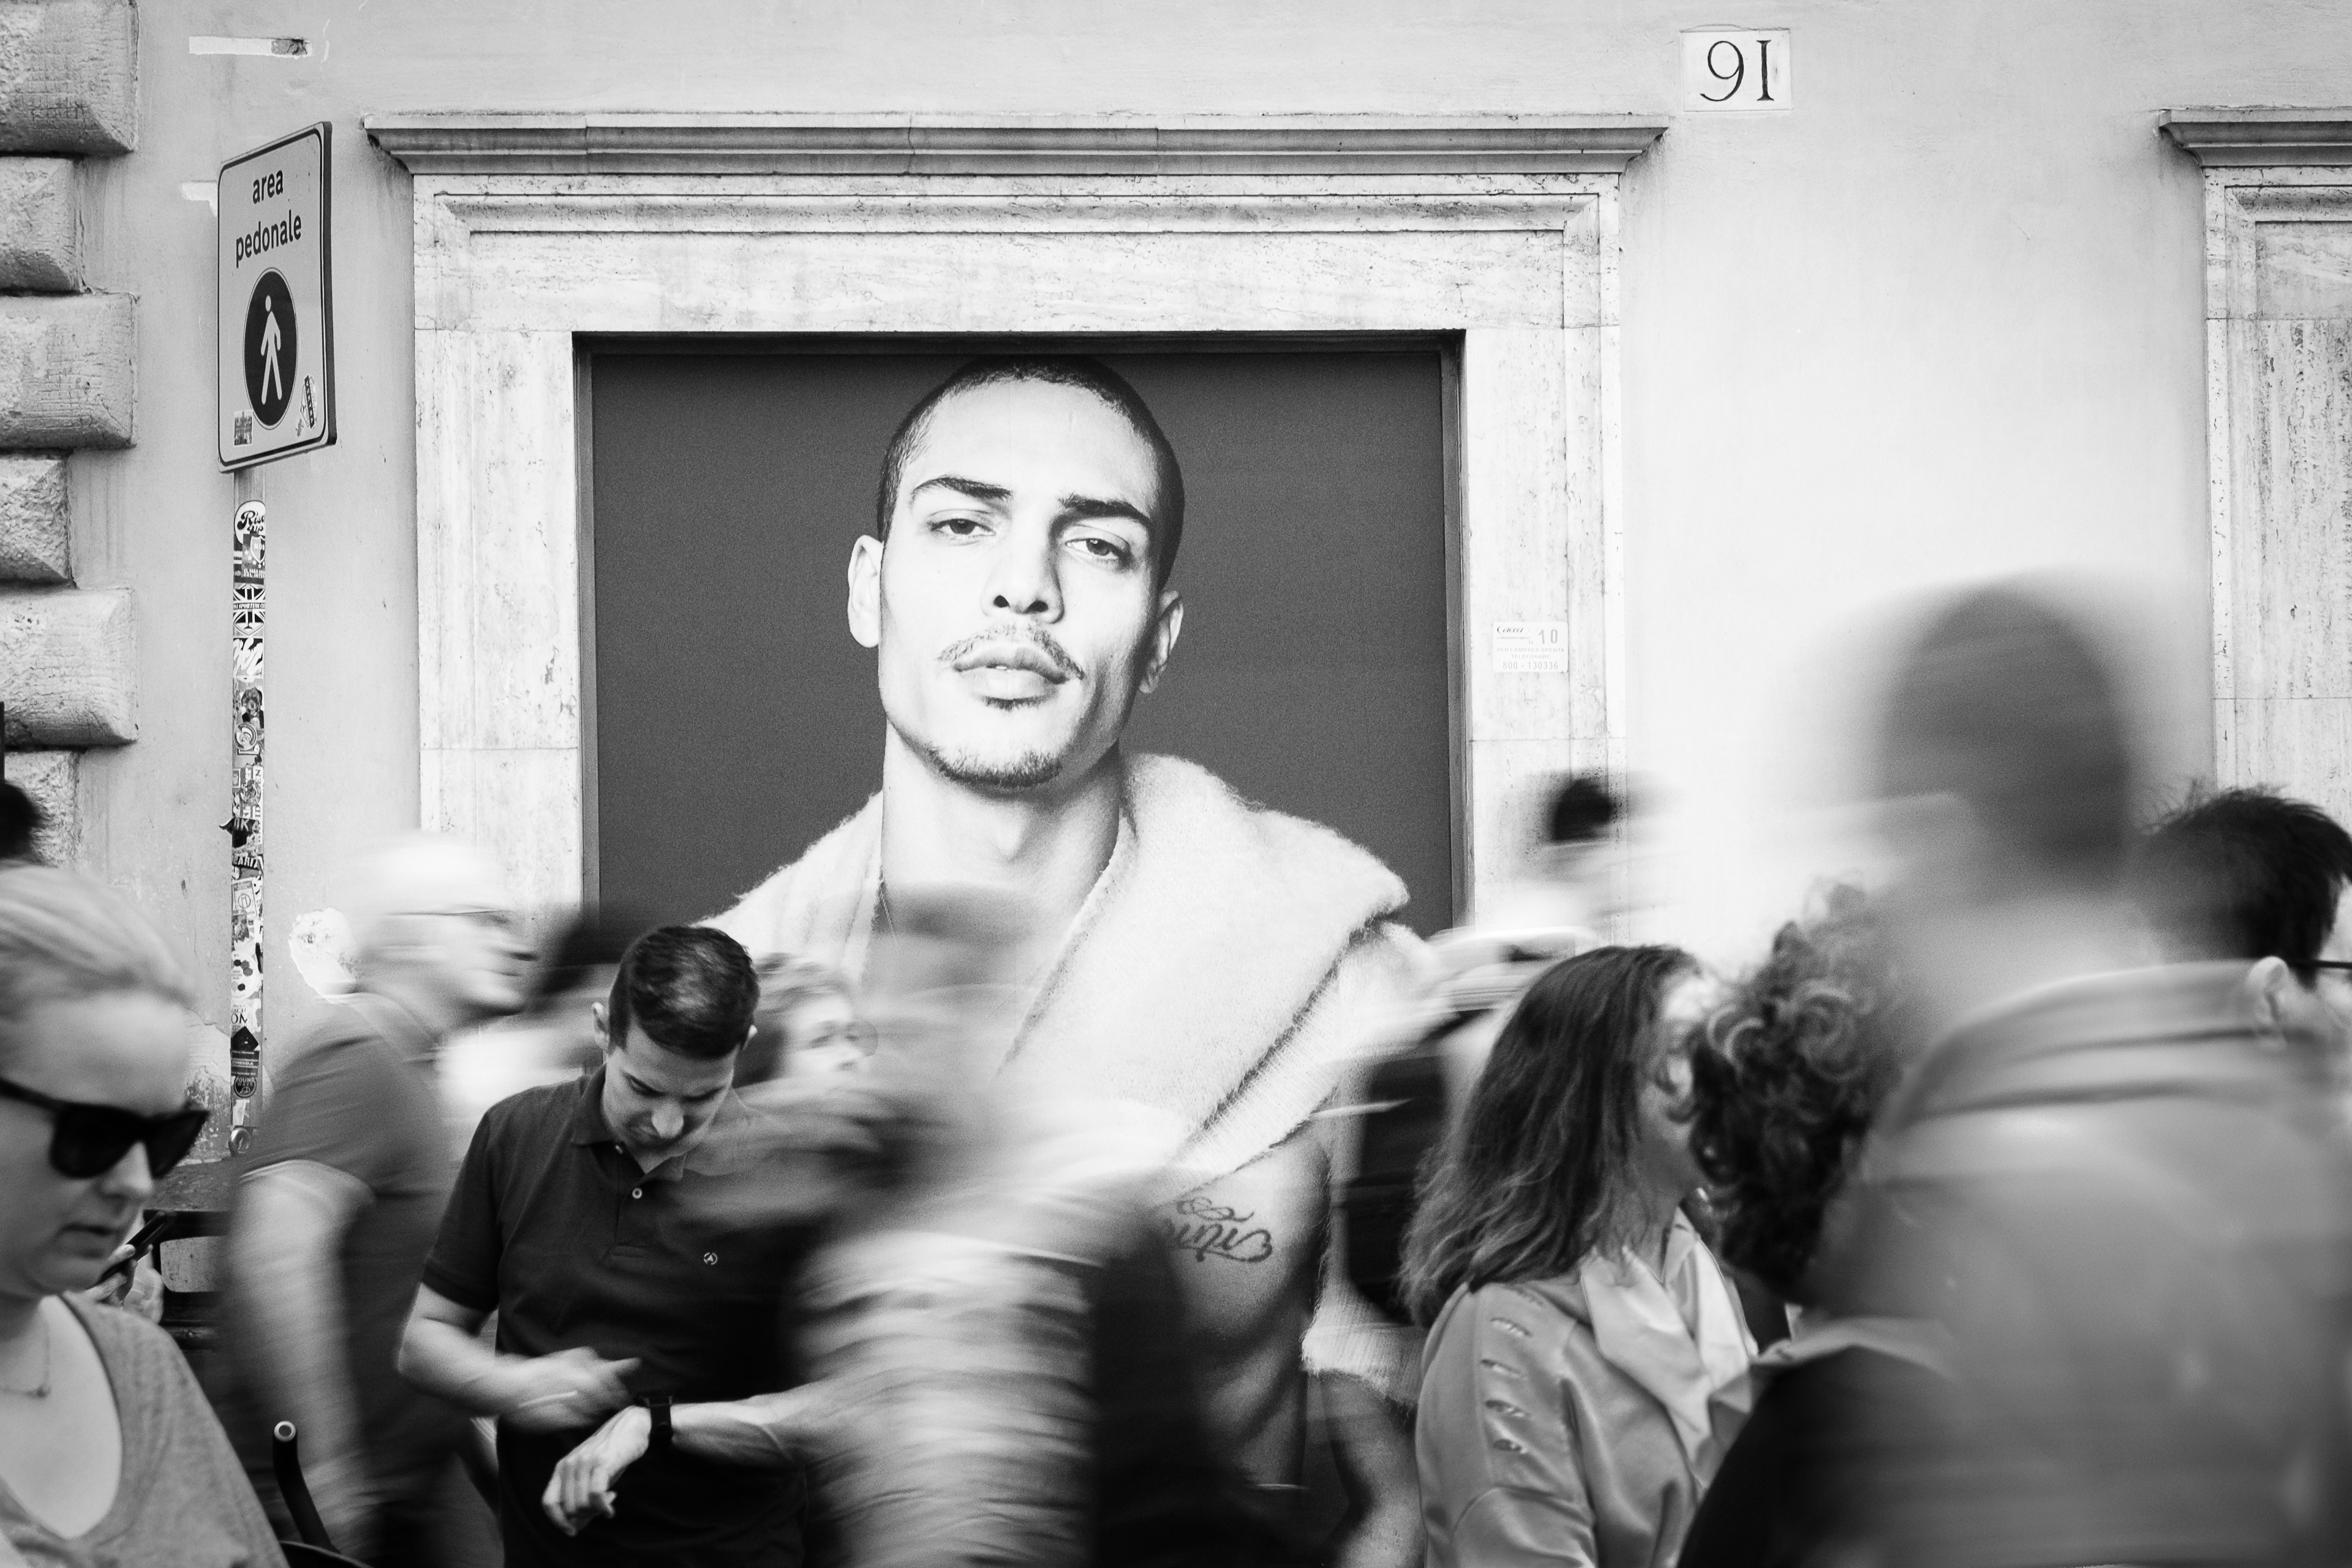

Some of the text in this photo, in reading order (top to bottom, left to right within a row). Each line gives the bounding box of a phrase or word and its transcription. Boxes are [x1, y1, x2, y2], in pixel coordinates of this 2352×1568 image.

[1700, 40, 1774, 102] 91
[252, 170, 284, 204] area
[235, 209, 302, 268] pedonale
[1538, 629, 1558, 644] 10
[1502, 661, 1518, 670] 800
[1528, 661, 1559, 670] 130336
